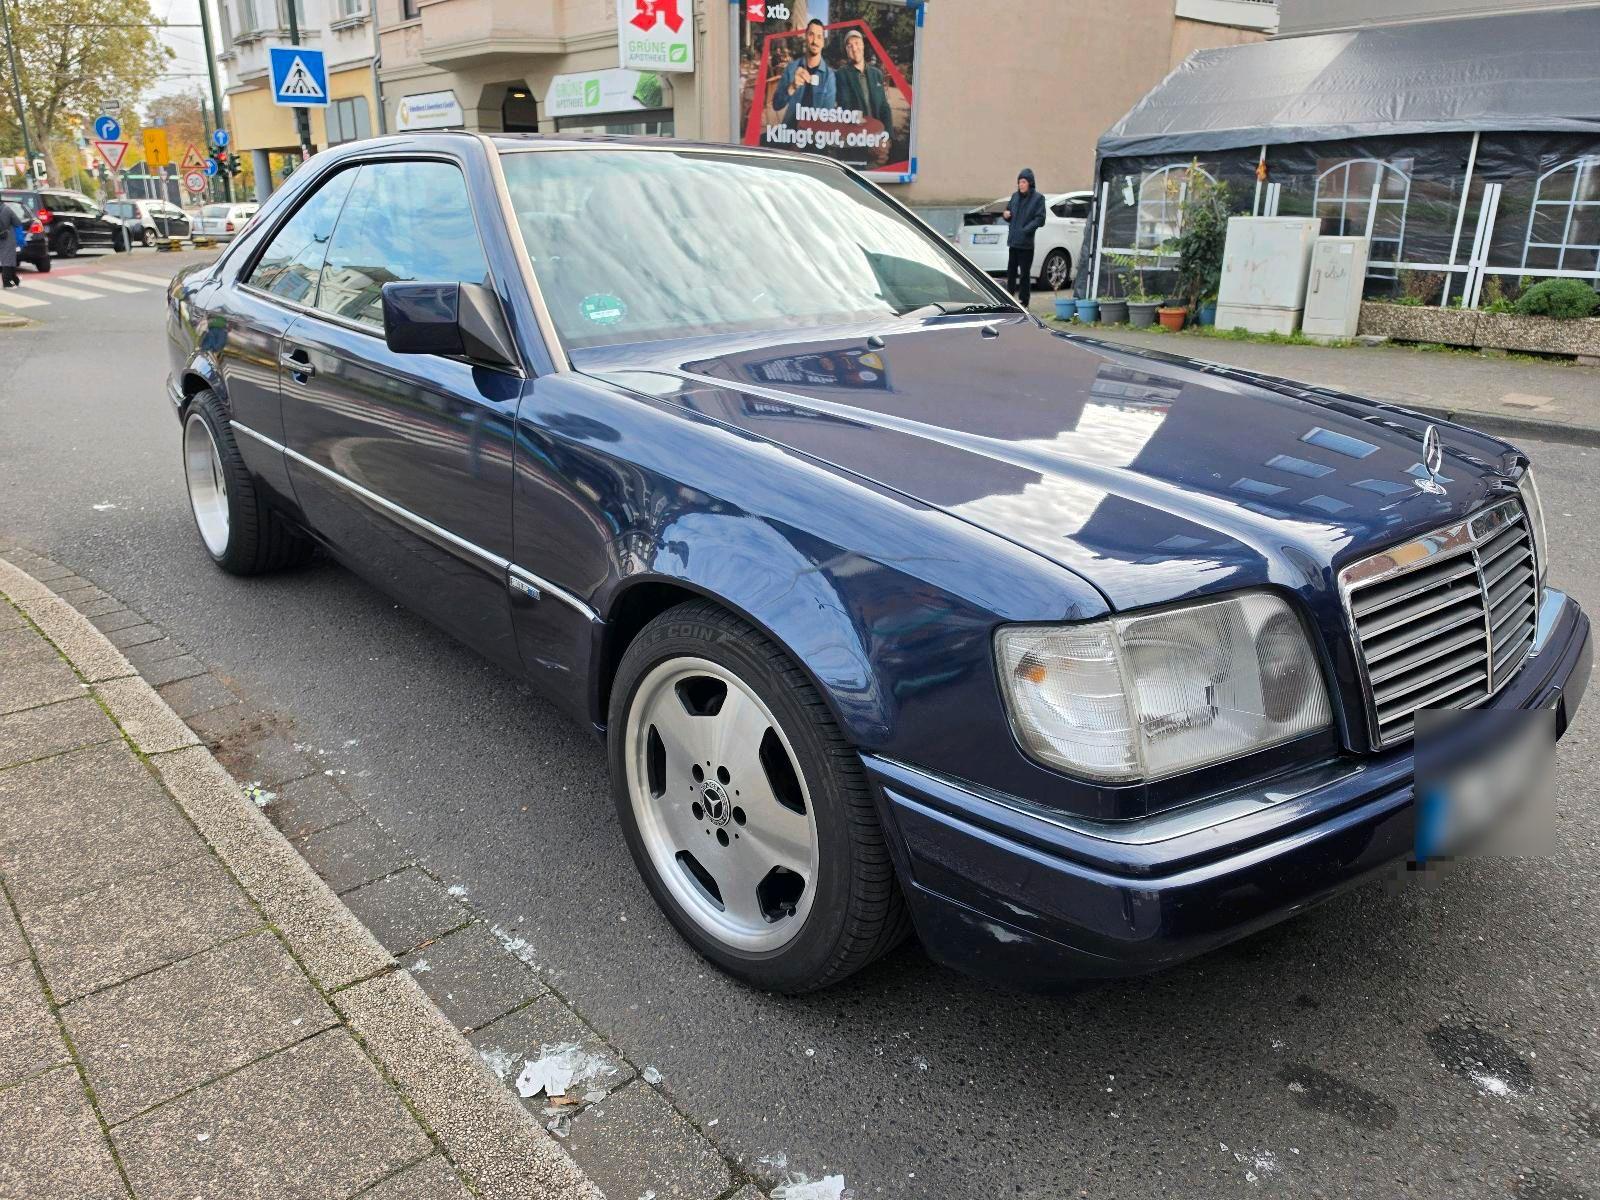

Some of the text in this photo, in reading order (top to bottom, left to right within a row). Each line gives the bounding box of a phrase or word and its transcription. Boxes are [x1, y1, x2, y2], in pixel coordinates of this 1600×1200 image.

[766, 3, 790, 20] xtb
[628, 40, 666, 52] GRÜNE
[629, 53, 666, 62] APOTHEKE
[766, 124, 890, 149] Klingt gut, oder?
[667, 623, 713, 641] COIN
